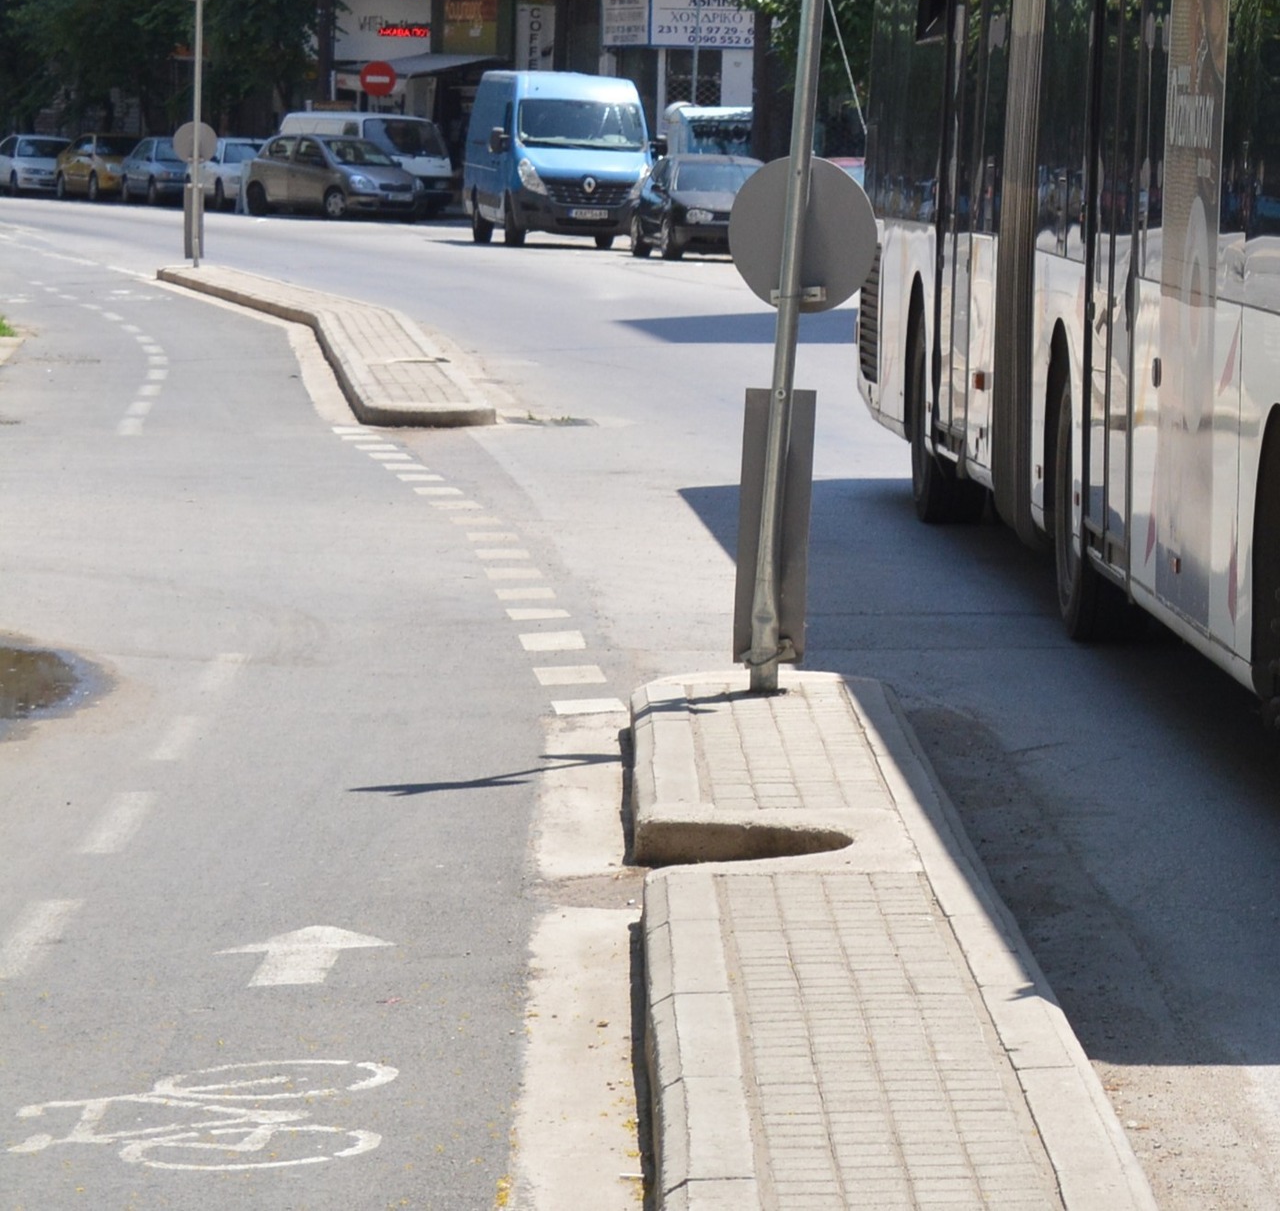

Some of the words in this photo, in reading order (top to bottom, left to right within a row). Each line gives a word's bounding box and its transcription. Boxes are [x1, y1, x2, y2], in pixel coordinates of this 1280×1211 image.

[658, 25, 678, 34] 231
[707, 26, 721, 35] 97
[724, 26, 739, 35] 29
[528, 7, 541, 70] COFFE
[720, 35, 742, 44] 552
